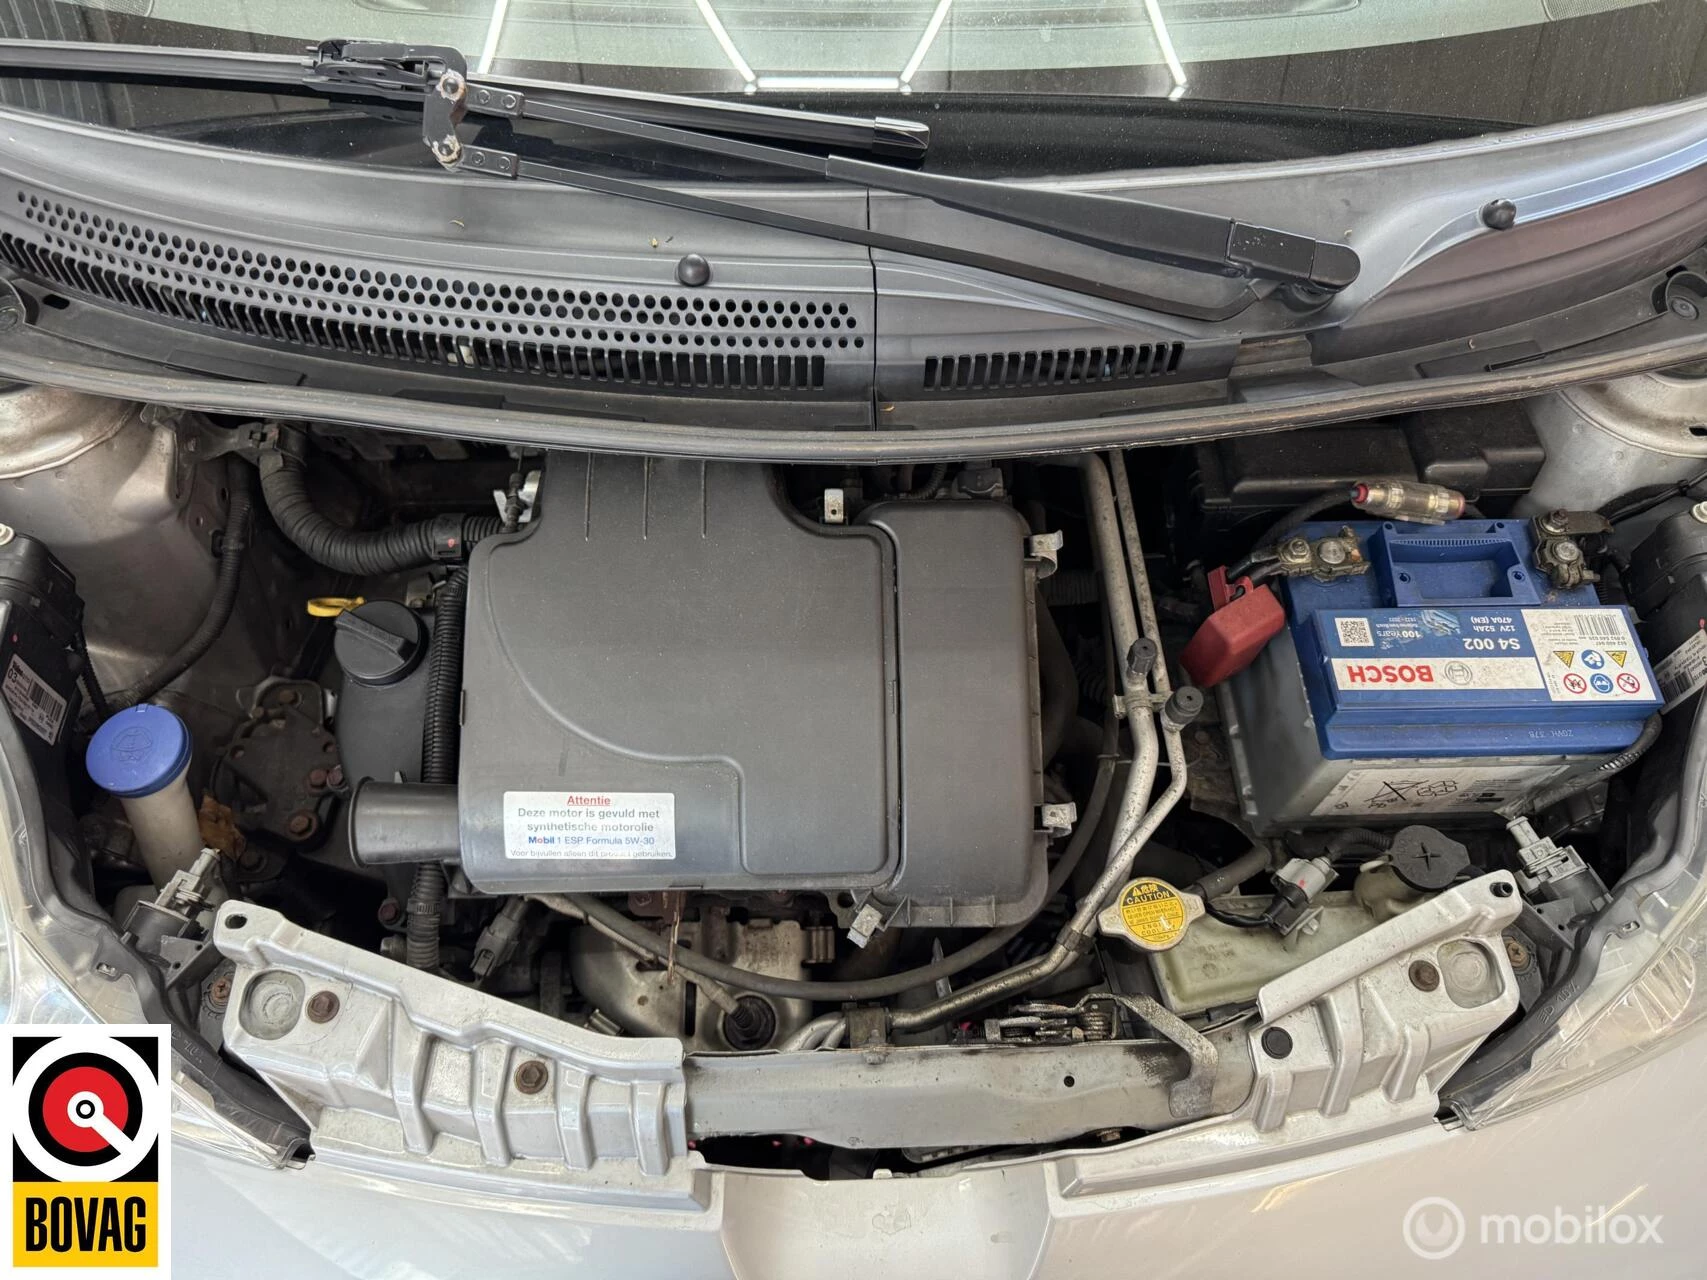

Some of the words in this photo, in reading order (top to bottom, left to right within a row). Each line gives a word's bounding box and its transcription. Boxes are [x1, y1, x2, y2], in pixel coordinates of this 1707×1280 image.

[1470, 615, 1489, 624] (EN)
[1490, 616, 1512, 624] 470A
[1462, 638, 1495, 650] 002
[1497, 638, 1521, 650] S4
[8, 668, 18, 683] 03
[1347, 664, 1434, 683] BOSCH
[567, 795, 611, 806] Attentie
[518, 808, 546, 818] Deze
[549, 809, 582, 818] motor
[585, 808, 595, 818] is
[598, 808, 635, 820] gevuld
[638, 810, 660, 819] met
[527, 822, 598, 833] synthetische
[601, 823, 654, 832] motorolie
[528, 836, 555, 844] Mobil
[586, 837, 623, 845] Formula
[625, 837, 655, 845] 5W-30
[510, 849, 529, 857] Voor
[588, 849, 599, 857] dit
[1126, 891, 1170, 904] CAUTION
